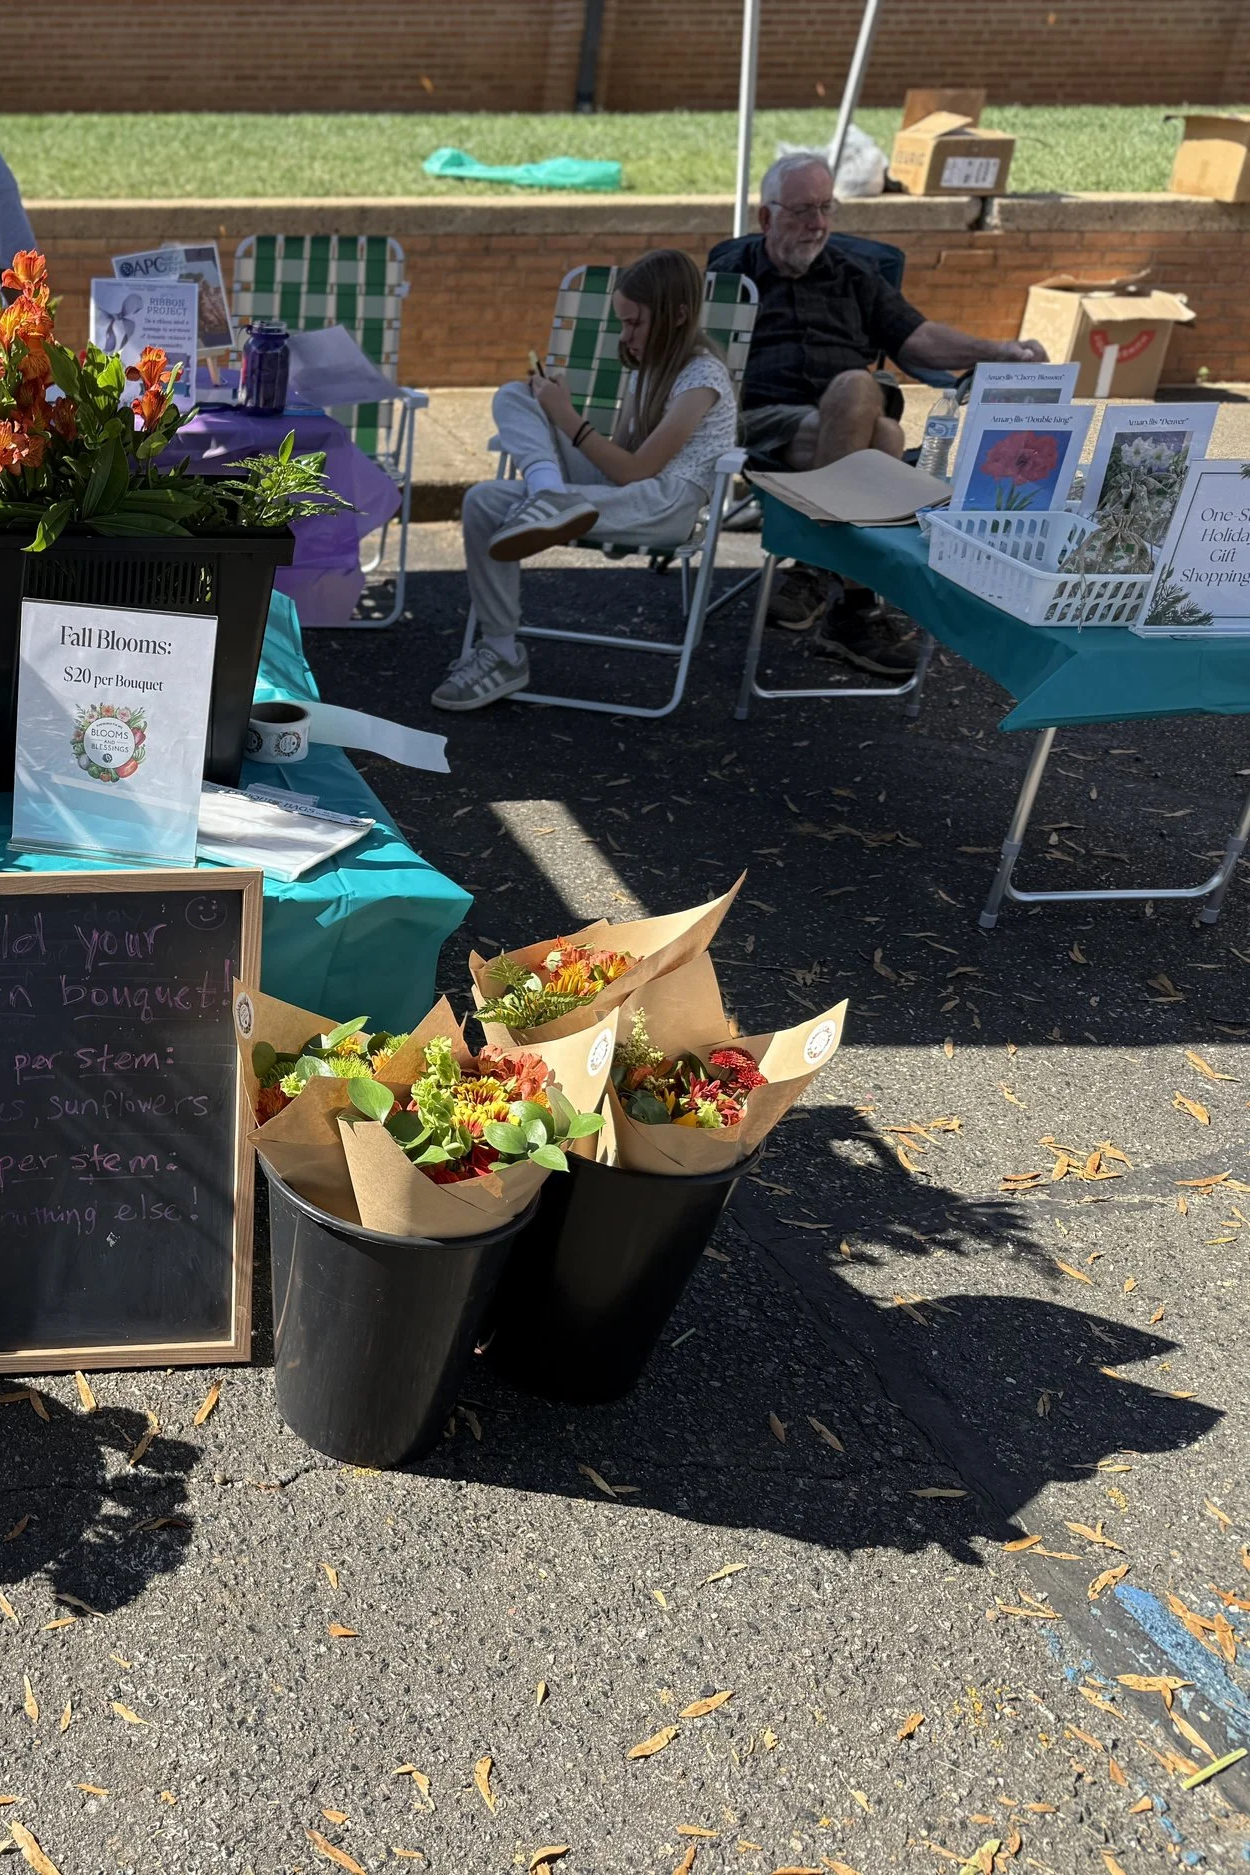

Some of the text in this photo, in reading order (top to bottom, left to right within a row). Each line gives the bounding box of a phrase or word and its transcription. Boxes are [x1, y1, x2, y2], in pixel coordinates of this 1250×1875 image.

[146, 306, 188, 316] PROJECT
[150, 297, 186, 307] RIBBON
[1201, 507, 1250, 522] One-S
[1210, 548, 1236, 562] Gift
[60, 625, 172, 655] Fall Blooms:
[63, 666, 163, 693] $20 per Bouquet
[91, 728, 129, 740] BLOOMS
[91, 743, 129, 753] BLESSINGS
[74, 923, 167, 973] your
[59, 959, 231, 1022] bouquet!
[13, 1050, 62, 1085] per
[73, 1044, 174, 1072] stem:
[47, 1088, 208, 1121] sunflowers
[70, 1143, 179, 1173] stem:
